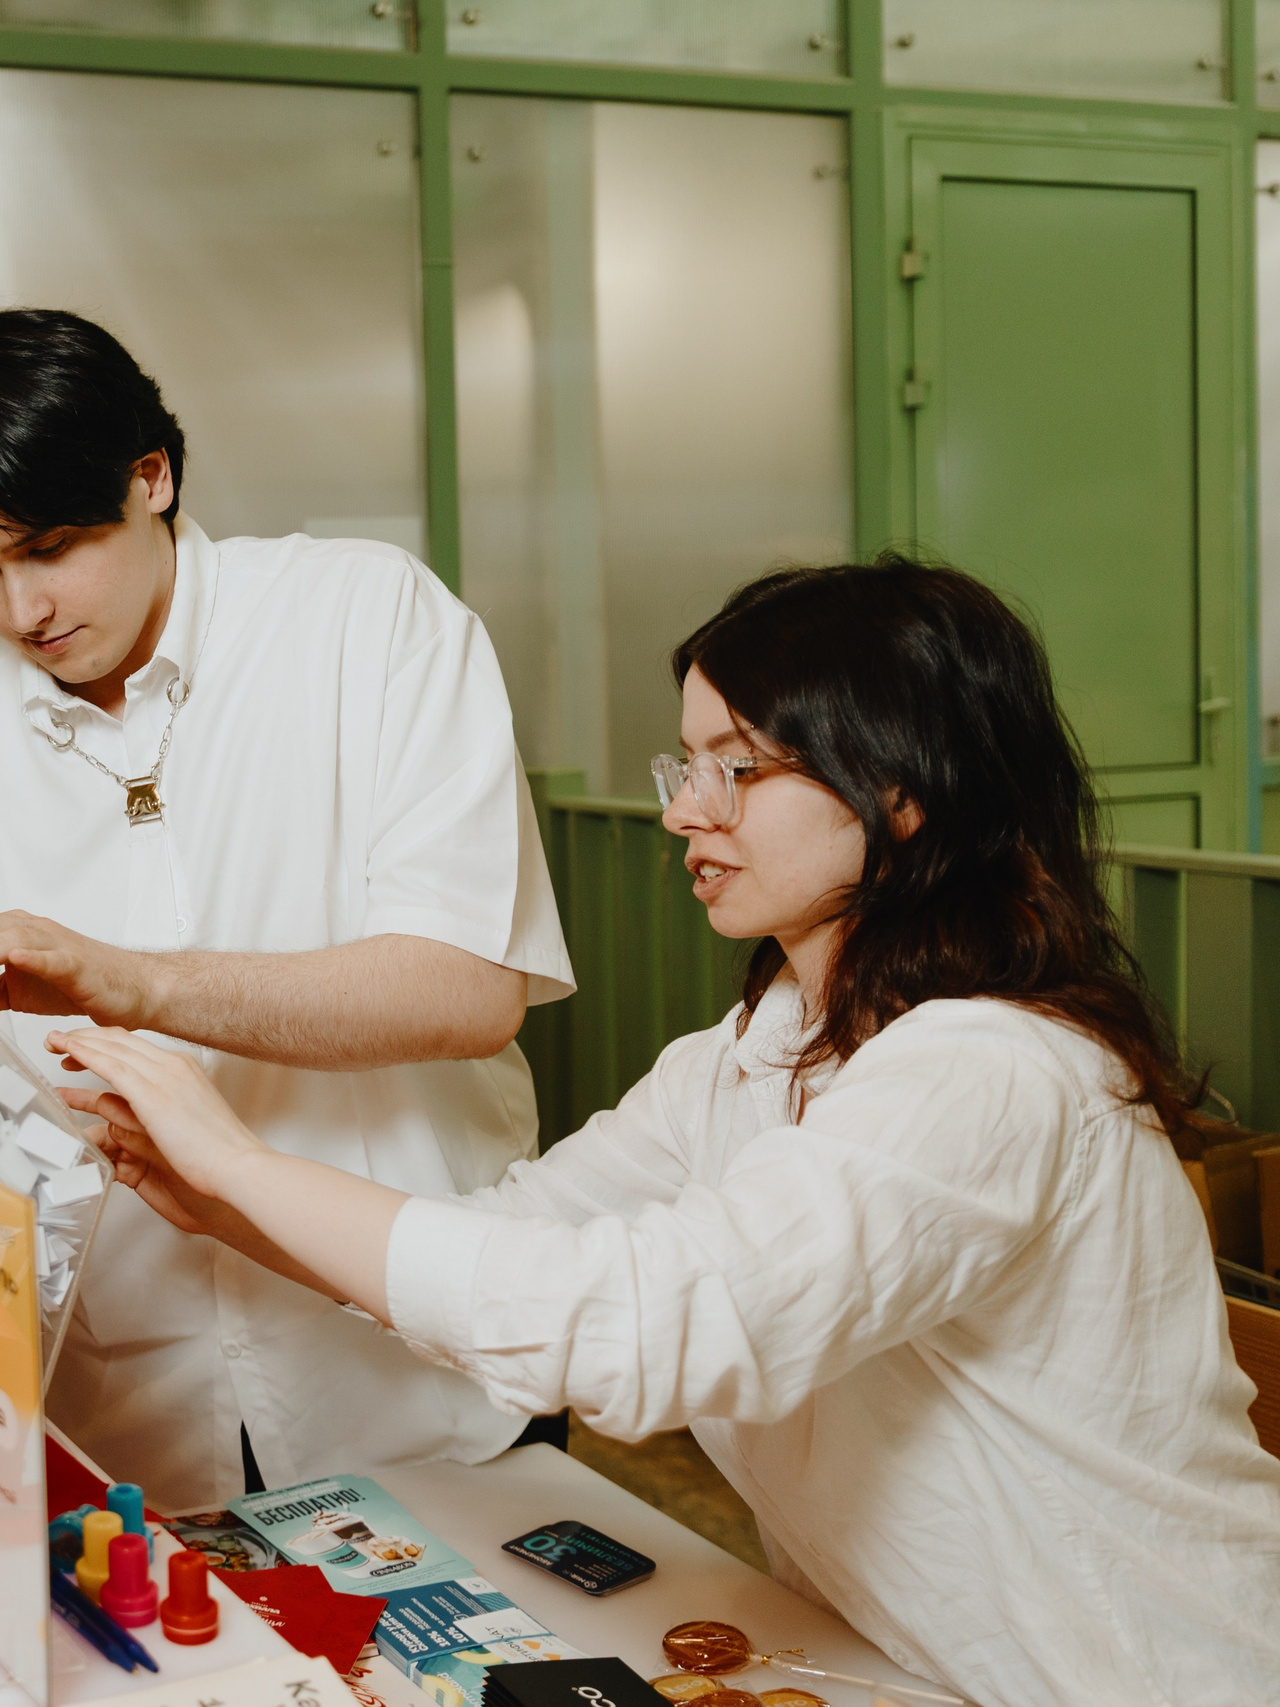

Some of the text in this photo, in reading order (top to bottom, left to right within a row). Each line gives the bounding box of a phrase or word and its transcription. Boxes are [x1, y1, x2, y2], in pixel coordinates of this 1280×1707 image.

[254, 1488, 366, 1526] БЕСПЛАТНО!
[523, 1535, 577, 1562] 30
[427, 1630, 451, 1647] 15%
[445, 1626, 469, 1643] 10%
